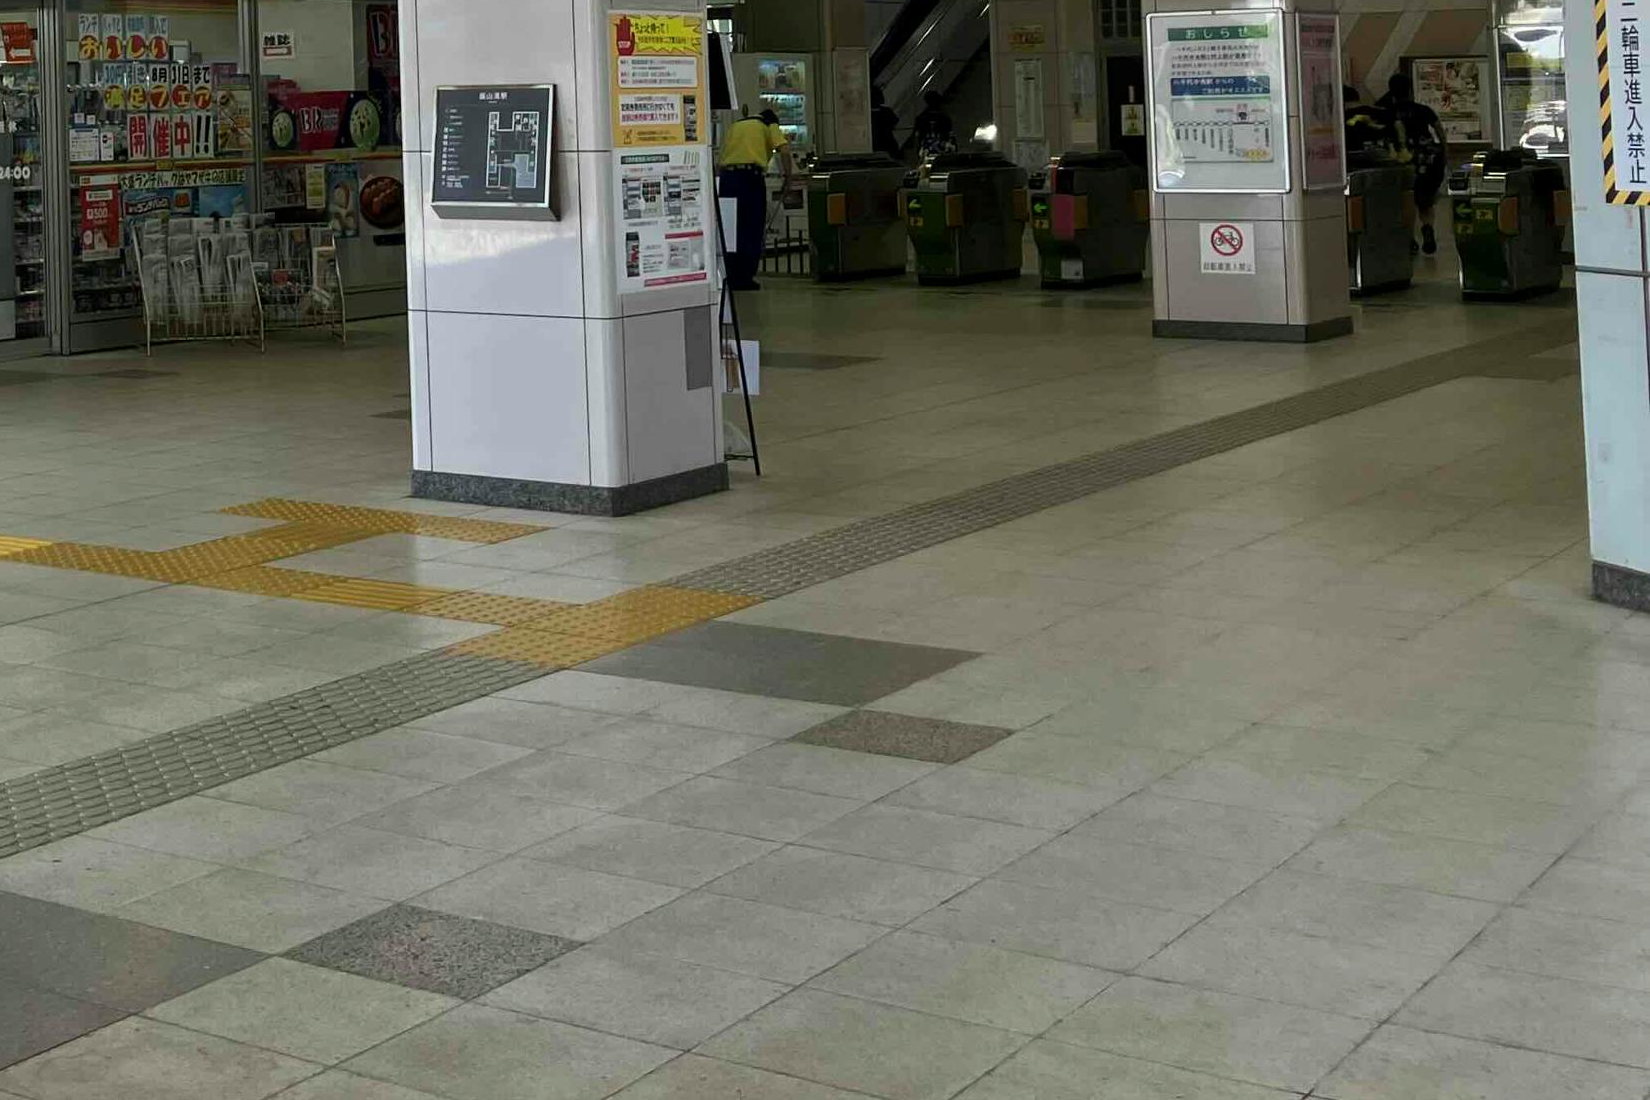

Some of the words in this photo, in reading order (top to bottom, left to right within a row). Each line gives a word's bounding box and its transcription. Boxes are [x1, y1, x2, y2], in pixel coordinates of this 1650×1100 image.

[1621, 2, 1647, 184] 二輪車進入禁止
